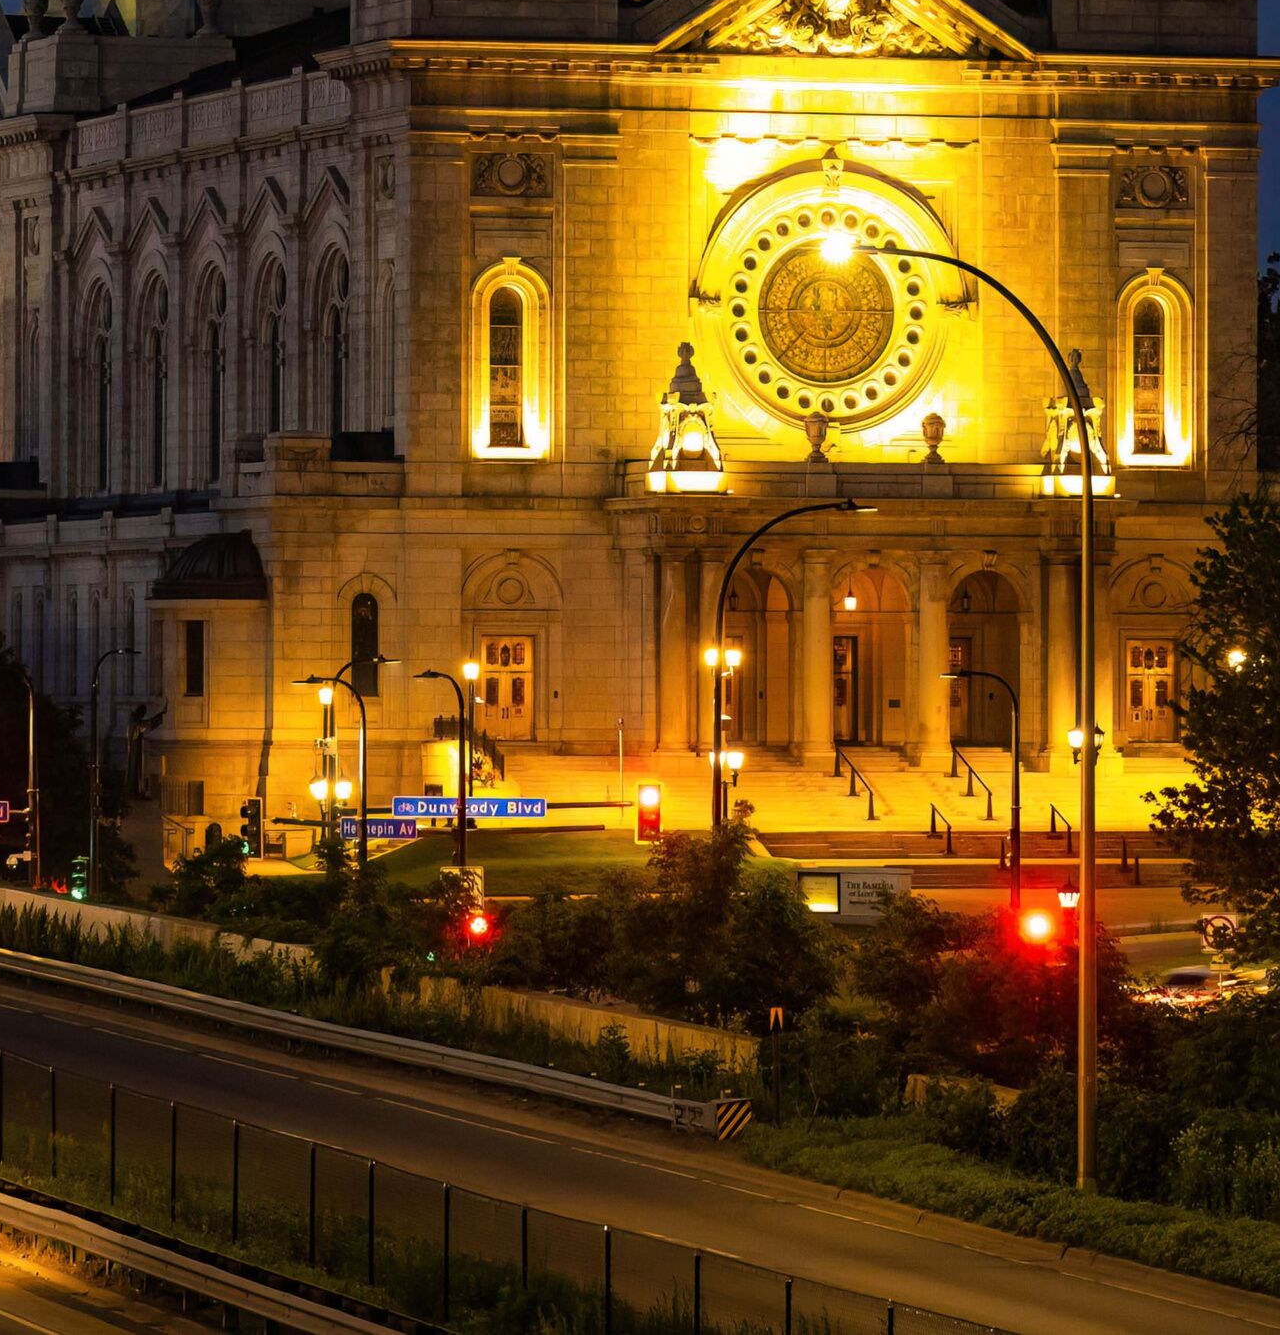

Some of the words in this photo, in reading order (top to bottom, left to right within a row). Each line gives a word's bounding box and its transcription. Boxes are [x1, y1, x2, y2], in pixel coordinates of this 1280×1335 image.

[507, 801, 542, 814] Blvd
[343, 821, 394, 837] Heepin
[399, 823, 414, 835] Av
